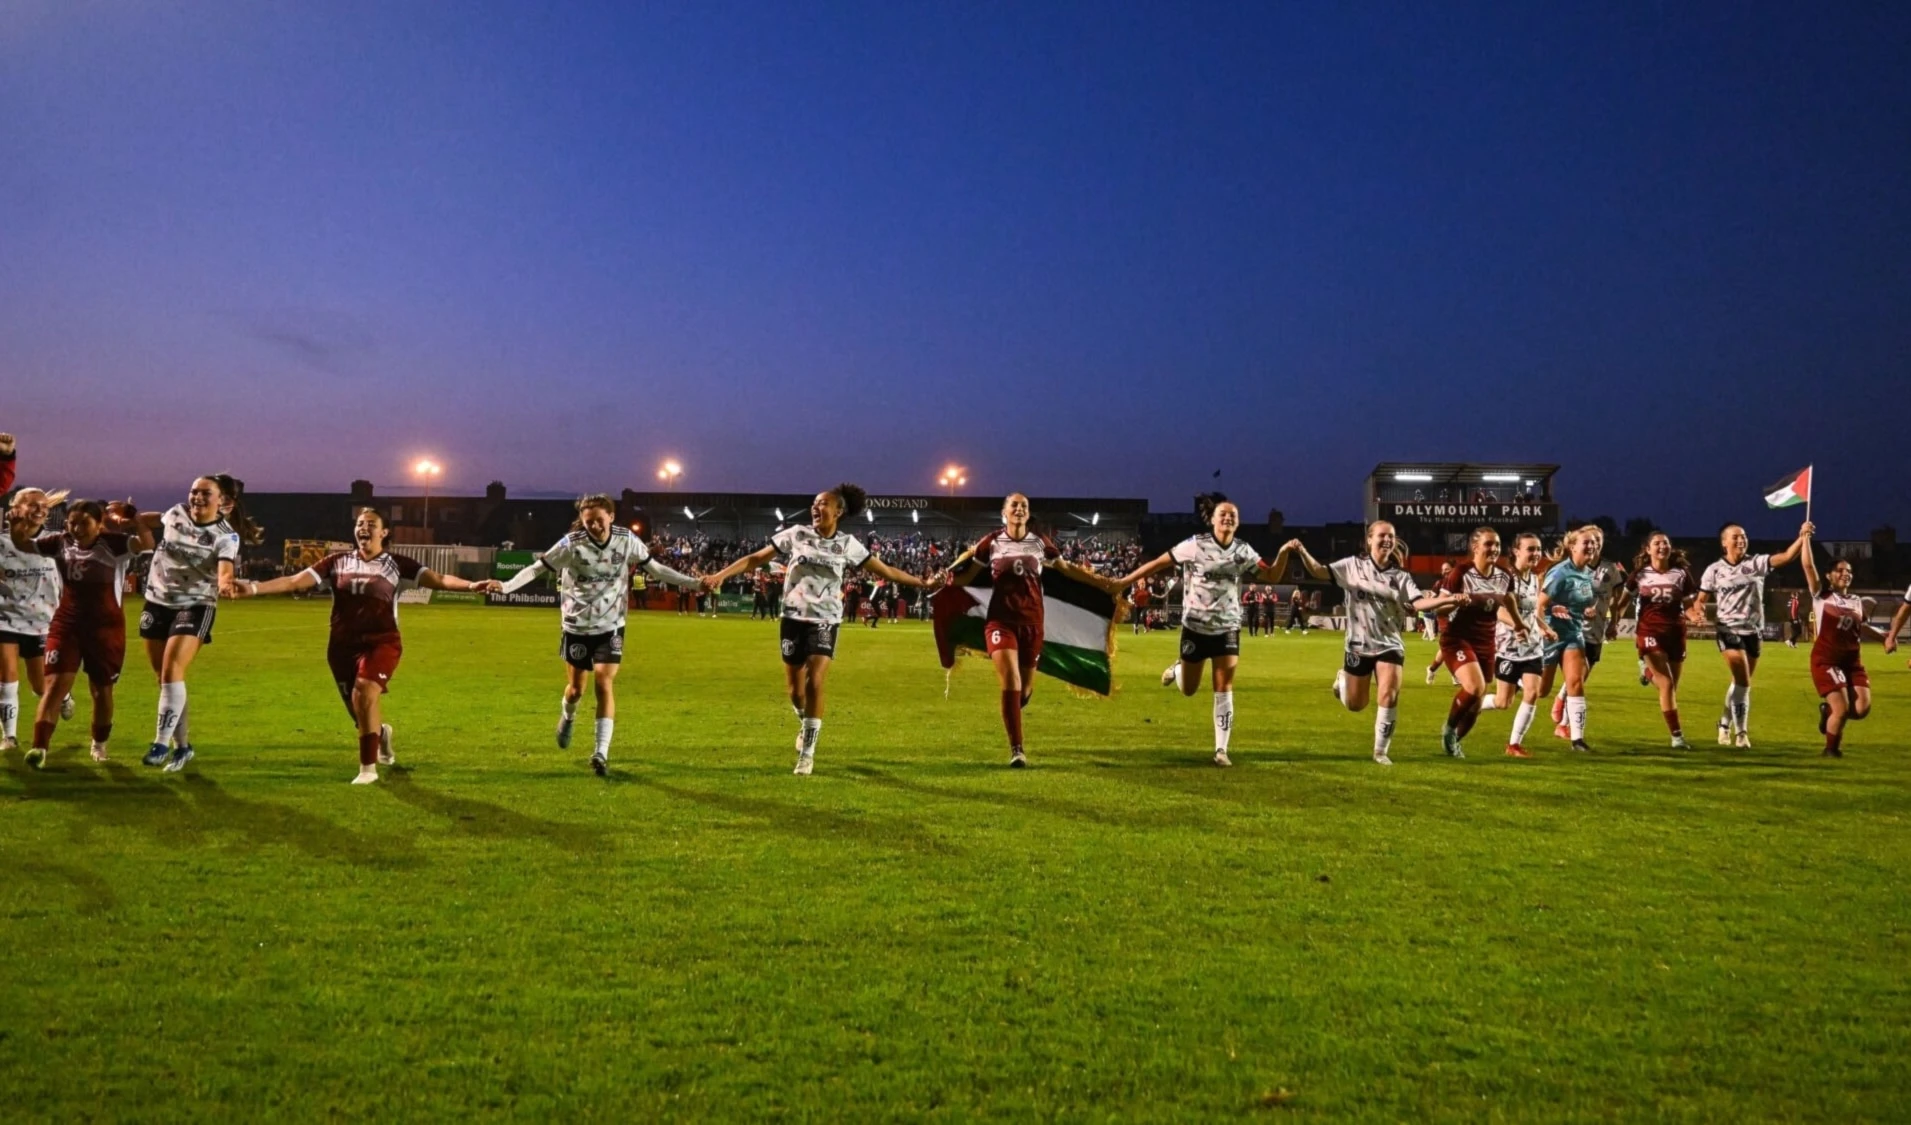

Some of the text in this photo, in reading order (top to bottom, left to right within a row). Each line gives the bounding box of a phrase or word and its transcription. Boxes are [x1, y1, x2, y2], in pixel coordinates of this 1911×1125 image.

[864, 498, 928, 508] ONO STAND
[1395, 505, 1542, 516] DALYMOUNT PARK
[66, 560, 85, 581] 18
[1013, 559, 1024, 575] 6
[351, 578, 370, 594] 17
[491, 592, 507, 602] The
[1650, 587, 1673, 603] 25
[1484, 598, 1495, 613] 8
[1836, 616, 1853, 631] 19
[991, 630, 1001, 644] 6
[45, 650, 59, 665] 18
[1456, 649, 1466, 662] 8
